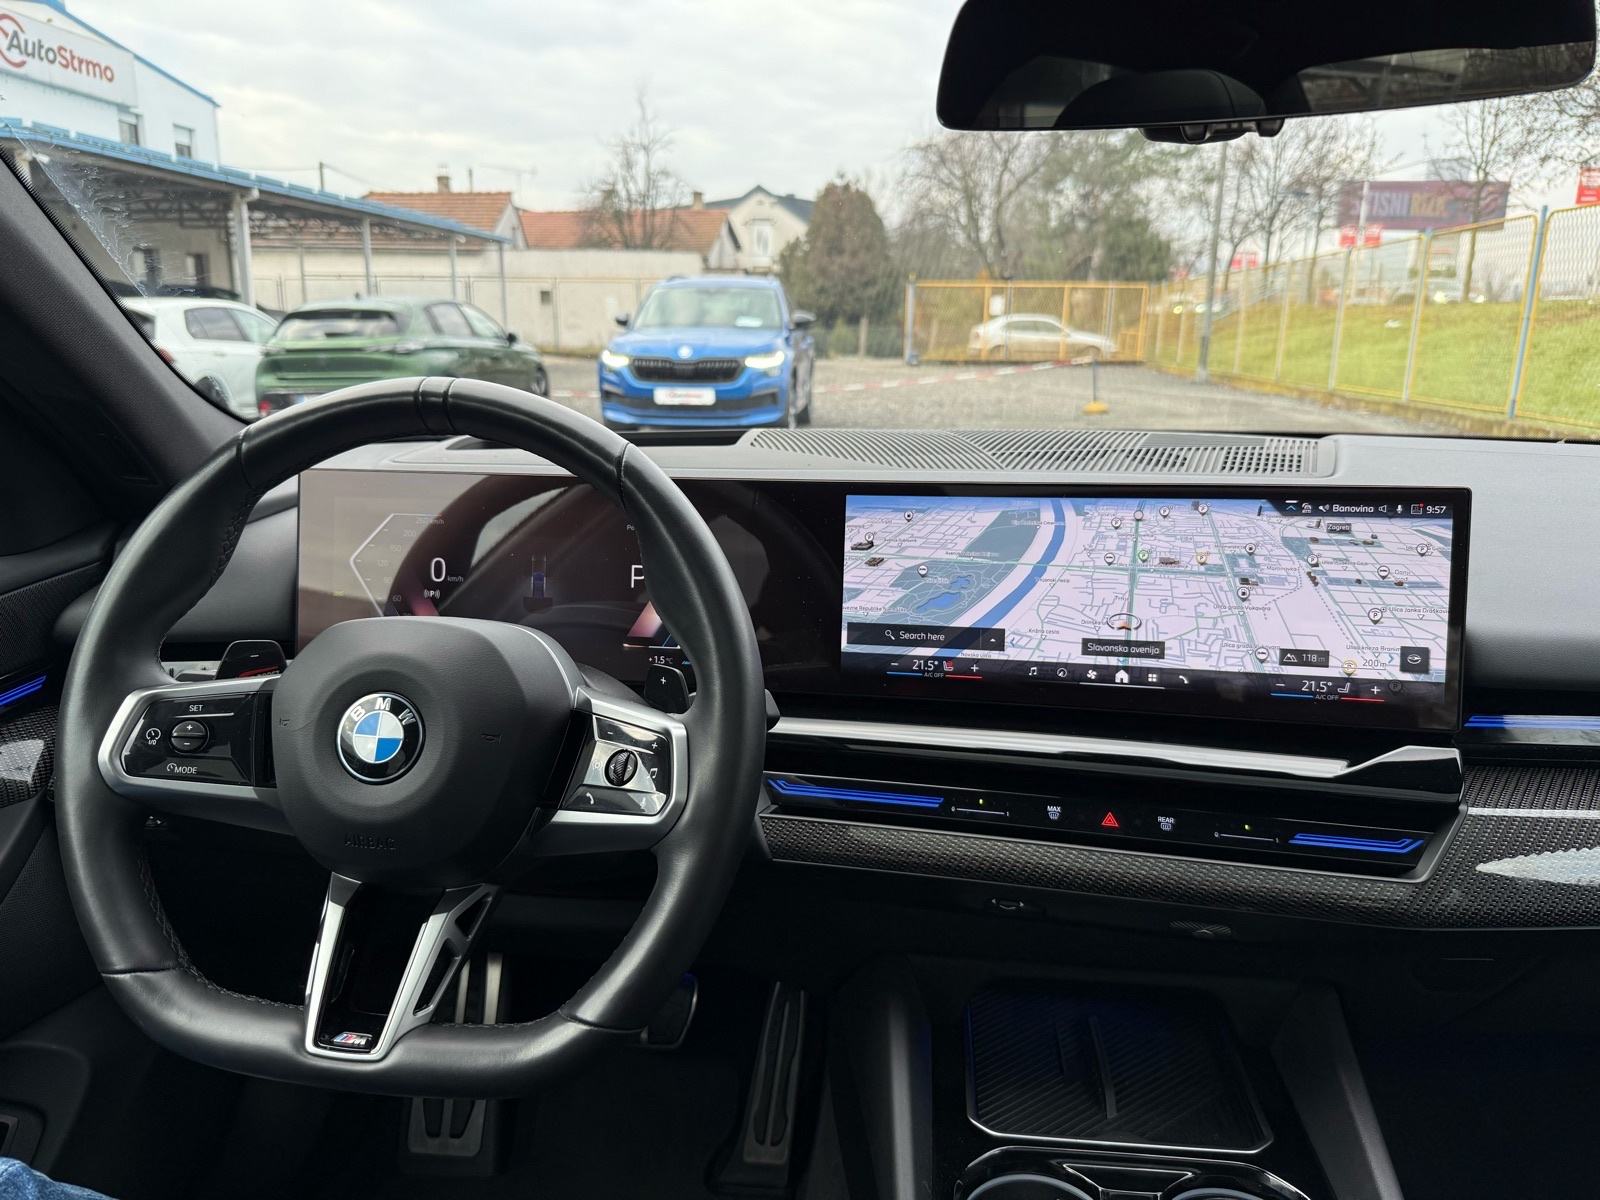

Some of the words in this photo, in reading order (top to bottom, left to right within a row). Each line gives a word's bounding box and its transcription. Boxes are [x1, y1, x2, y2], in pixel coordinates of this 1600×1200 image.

[6, 30, 115, 83] AutoStrmo
[1332, 504, 1374, 513] Banovina
[1426, 505, 1447, 514] 9:57
[430, 557, 447, 583] 0
[447, 575, 464, 583] km/h
[899, 630, 927, 640] Search
[927, 632, 945, 641] here
[1087, 643, 1129, 653] Slavonska
[1130, 646, 1160, 656] avenija
[1301, 653, 1318, 663] 118
[1362, 658, 1379, 667] 200
[912, 660, 939, 670] 21.5°
[1301, 680, 1333, 692] 21.5°
[189, 704, 204, 712] SET
[350, 697, 416, 726] BMW
[174, 766, 198, 774] MODE
[1157, 816, 1175, 824] REAR
